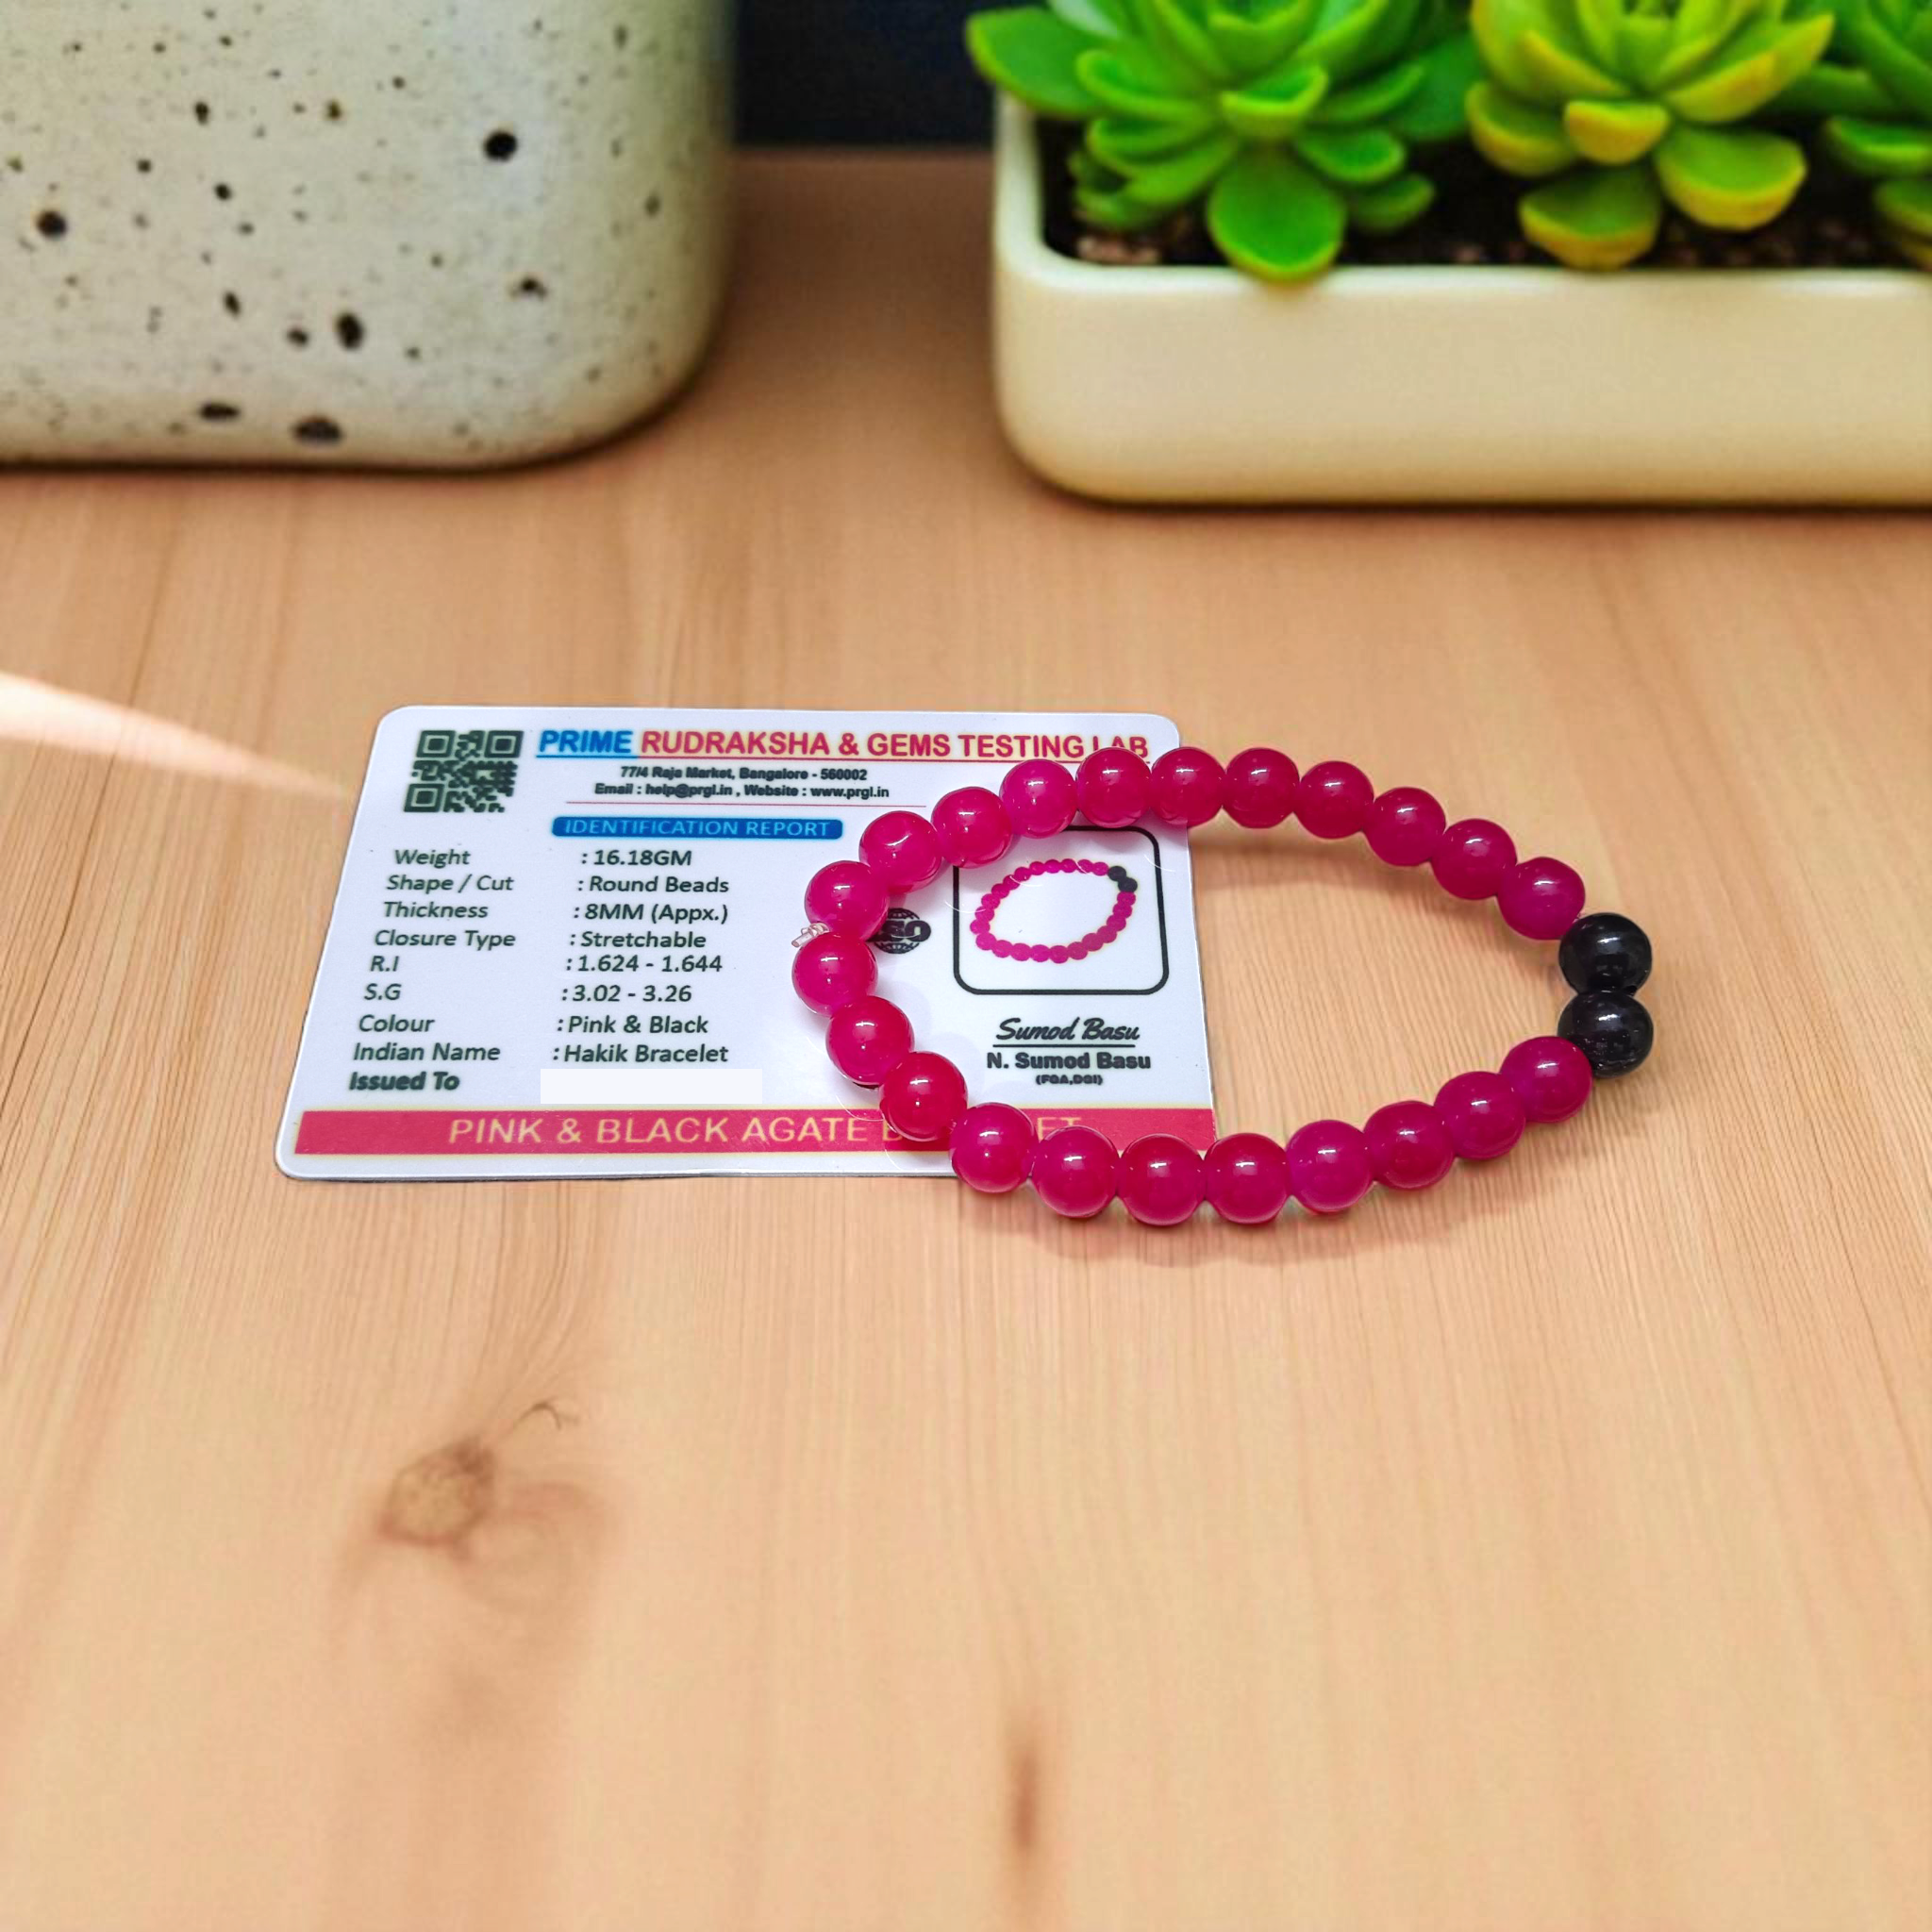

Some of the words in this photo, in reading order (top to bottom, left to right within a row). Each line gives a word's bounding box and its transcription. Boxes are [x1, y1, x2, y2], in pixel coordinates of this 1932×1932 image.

[539, 730, 633, 754] PRIME
[641, 731, 829, 756] RUDRAKSHA
[838, 733, 859, 756] &
[867, 733, 951, 757] GEMS
[958, 735, 1084, 758] TESTING
[621, 766, 648, 778] 77/4
[652, 766, 682, 781] Raja
[685, 767, 735, 780] Market,
[740, 767, 808, 782] Bangalore
[821, 769, 867, 780] 560002
[595, 783, 633, 795] Email
[645, 784, 732, 798] help@prgl.in
[744, 786, 798, 796] Website
[810, 786, 889, 799] www.prgl.in
[567, 821, 739, 834] IDENTIFICATION
[746, 822, 830, 836] REPORT
[394, 849, 471, 869] Weight
[593, 850, 691, 865] 16.18GM
[387, 874, 453, 894] Shape
[458, 874, 473, 893] /
[476, 875, 514, 891] Cut
[590, 876, 658, 892] Round
[665, 876, 729, 892] Beads
[383, 901, 488, 918] Thickness
[585, 904, 644, 920] 8MM
[651, 904, 728, 924] (Appx.)
[375, 929, 457, 946] Closure
[465, 930, 516, 951] Type
[580, 931, 707, 948] Stretchable
[370, 956, 399, 972] R.I
[577, 955, 639, 972] 1.624
[661, 955, 723, 973] 1.644
[364, 983, 402, 1000] S.G
[572, 985, 621, 1002] 3.02
[642, 985, 691, 1002] 3.26
[358, 1014, 435, 1032] Colour
[568, 1015, 616, 1033] Pink
[624, 1016, 641, 1033] &
[649, 1016, 708, 1033] Black
[996, 1017, 1080, 1040] Sumod
[1082, 1018, 1140, 1040] Basu
[353, 1042, 425, 1061] Indian
[432, 1043, 500, 1060] Name
[564, 1044, 627, 1062] Hakik
[635, 1044, 728, 1062] Bracelet
[987, 1053, 1009, 1069] N.
[1015, 1052, 1090, 1069] Sumod
[1097, 1052, 1151, 1069] Basu
[349, 1072, 426, 1091] Issued
[433, 1072, 460, 1091] To
[449, 1118, 543, 1143] PINK
[557, 1118, 581, 1143] &
[597, 1117, 728, 1143] BLACK
[741, 1117, 867, 1142] AGATE
